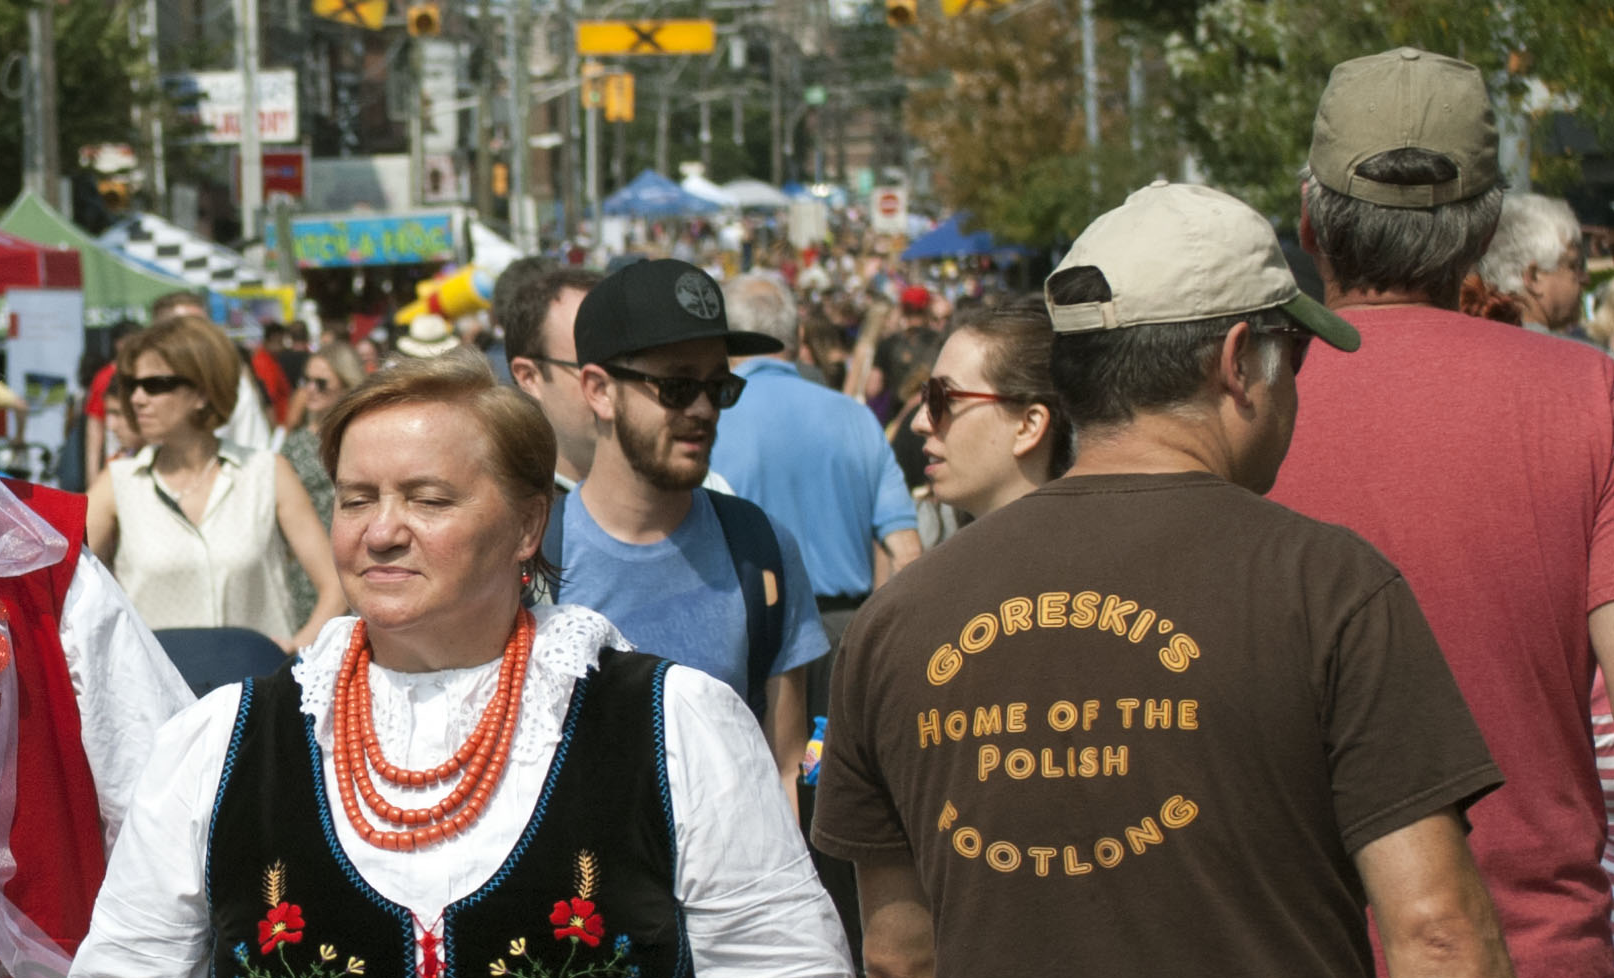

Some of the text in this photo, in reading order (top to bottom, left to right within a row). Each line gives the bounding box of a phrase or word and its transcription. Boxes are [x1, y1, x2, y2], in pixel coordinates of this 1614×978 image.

[926, 590, 1200, 686] GORESKI'S
[917, 698, 1199, 748] HOME OF THE
[978, 744, 1129, 782] POLISH
[938, 794, 1199, 877] FOOTLONG
